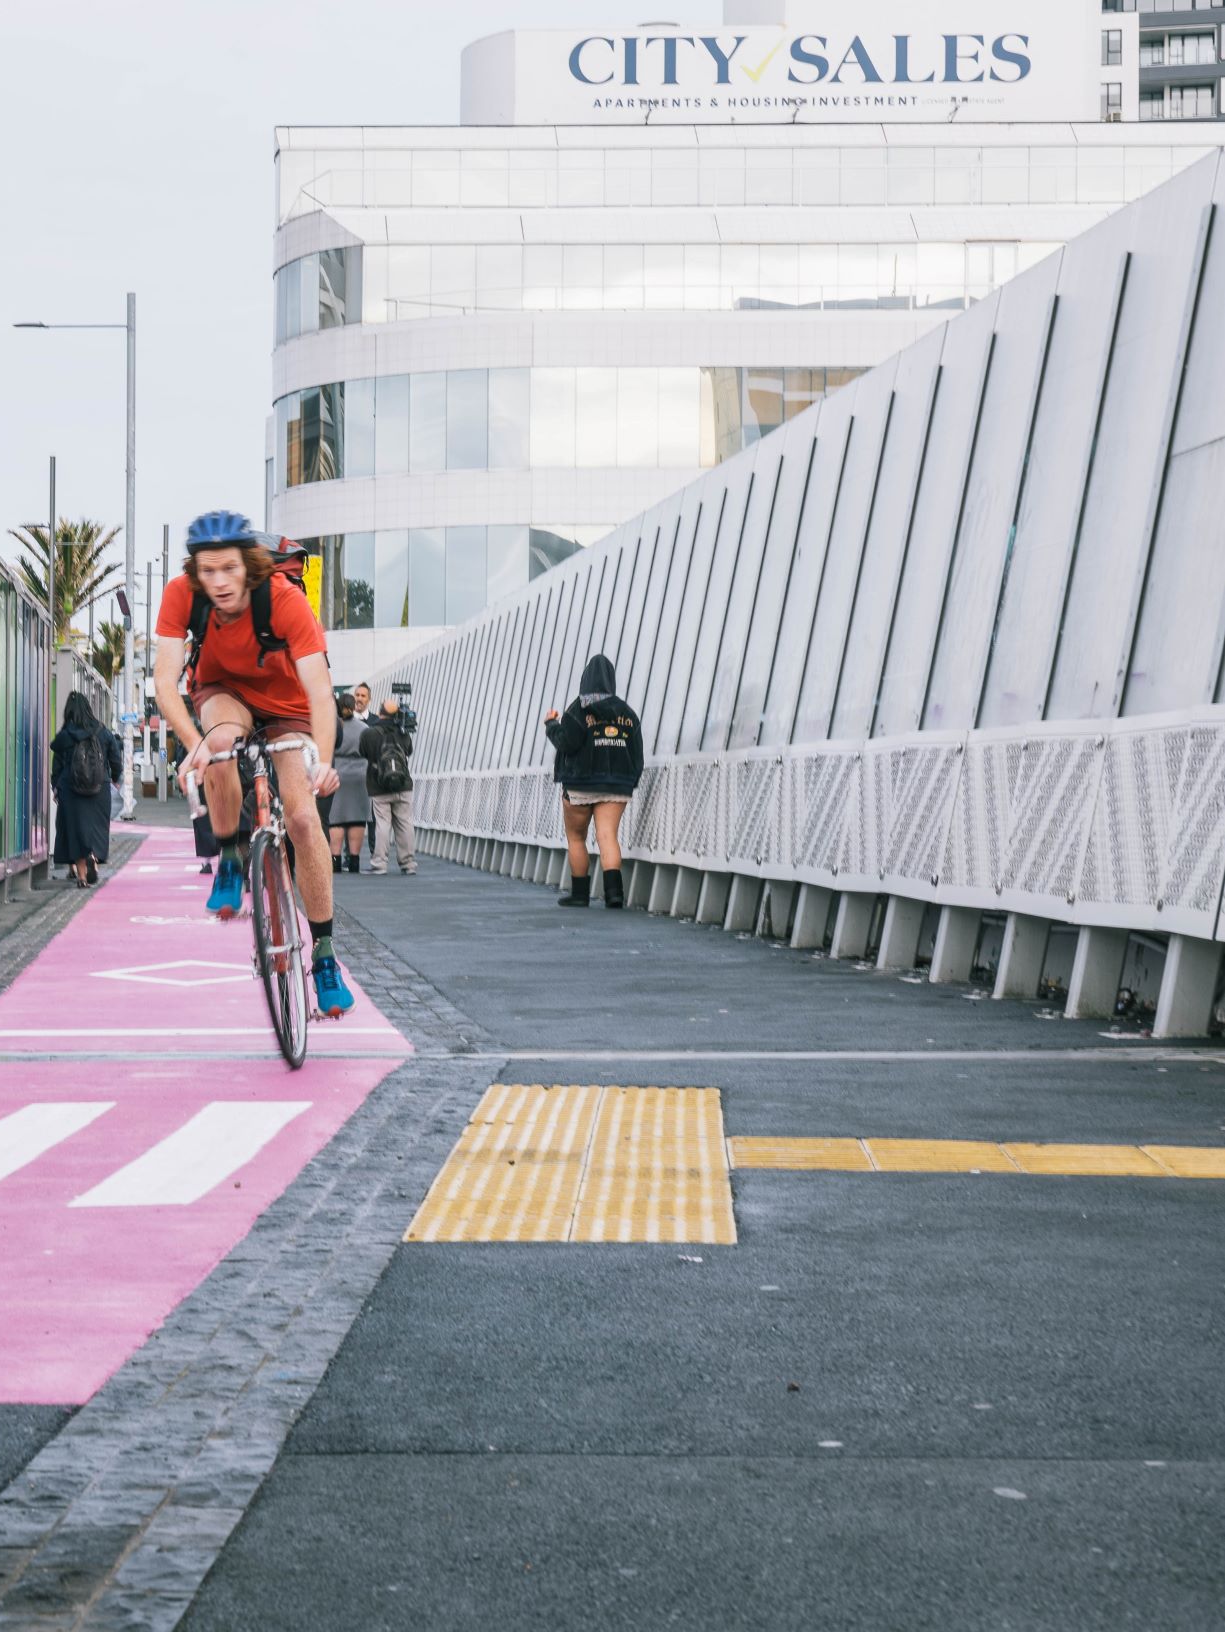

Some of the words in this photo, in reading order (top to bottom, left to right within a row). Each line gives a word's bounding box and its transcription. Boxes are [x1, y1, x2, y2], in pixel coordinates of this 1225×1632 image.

[568, 36, 747, 86] CITY
[787, 33, 1032, 84] SALES
[592, 97, 702, 109] APARTMENTS
[709, 97, 719, 108] &
[727, 96, 804, 108] HOUSING
[812, 95, 918, 107] INVESTMENT
